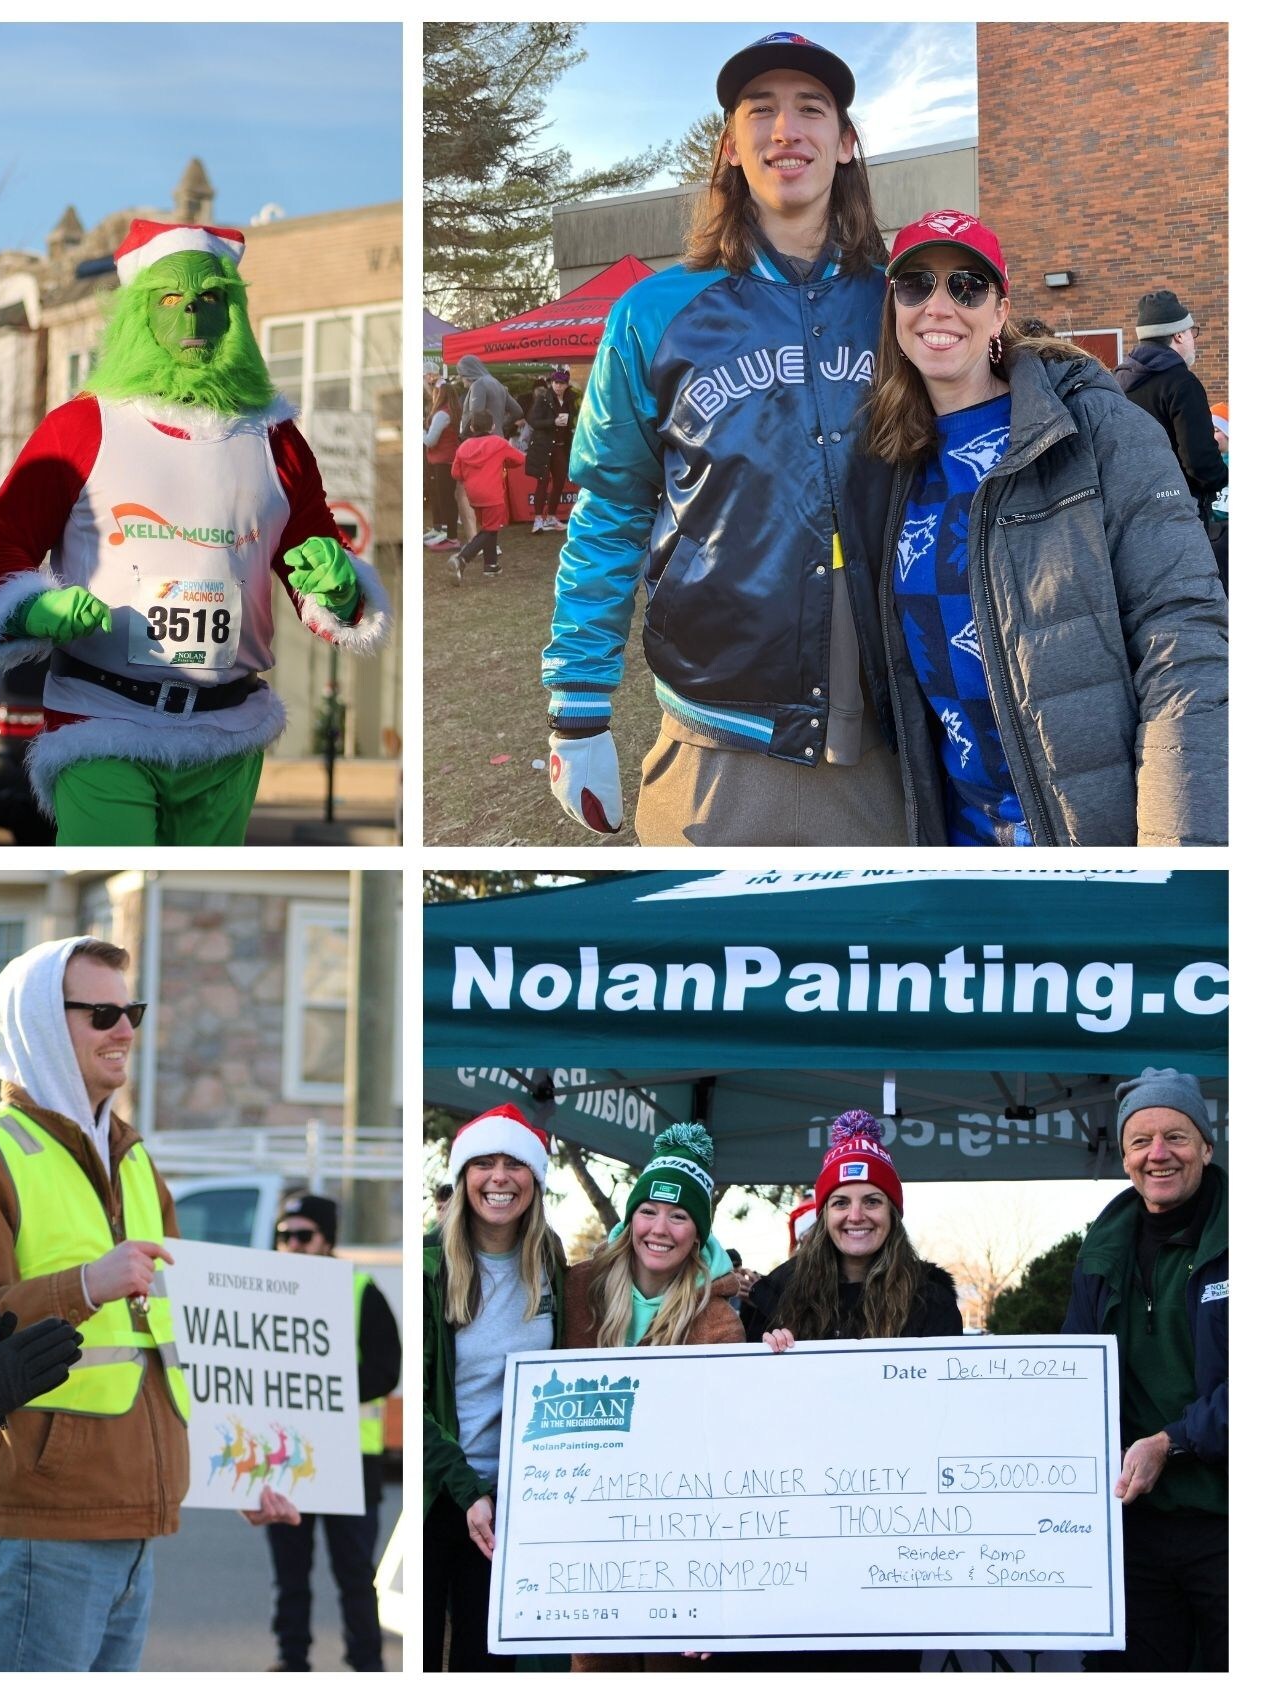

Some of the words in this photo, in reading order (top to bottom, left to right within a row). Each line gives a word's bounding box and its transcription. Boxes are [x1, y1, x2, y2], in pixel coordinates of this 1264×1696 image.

[686, 345, 805, 423] BLUE
[123, 523, 178, 541] KELLY
[182, 526, 235, 545] MUSIC
[183, 580, 204, 591] BRYN
[205, 581, 225, 592] MAWR
[183, 592, 213, 602] RACING
[214, 592, 225, 603] CO
[146, 605, 231, 644] 3518
[178, 651, 204, 660] NOLAN
[208, 1272, 264, 1293] REINDEER
[266, 1278, 300, 1296] ROMP
[183, 1305, 330, 1357] WALKERS
[882, 1364, 927, 1380] Date
[947, 1357, 984, 1380] Dec.
[989, 1358, 1012, 1380] 14,
[1018, 1359, 1076, 1377] 2024
[264, 1369, 344, 1413] HERE
[542, 1398, 628, 1419] NOLAN
[541, 1419, 549, 1429] IN
[550, 1419, 565, 1428] THE
[565, 1417, 625, 1428] NEIGHBORHOOD
[532, 1440, 624, 1452] NolanPainting.com
[523, 1465, 550, 1480] Pay
[556, 1467, 568, 1479] to
[571, 1463, 592, 1478] the
[588, 1471, 713, 1500] AMERICAN
[724, 1468, 807, 1496] CANCER
[824, 1467, 911, 1495] SOCIETY
[522, 1487, 559, 1502] Order
[561, 1488, 577, 1504] of
[829, 1505, 973, 1536] THOUSAND
[1037, 1518, 1094, 1535] Dollars
[897, 1545, 966, 1562] Reindeer
[980, 1544, 1026, 1565] Romp
[549, 1560, 675, 1593] REINDEER
[688, 1559, 755, 1589] ROMP
[758, 1560, 808, 1587] 2024
[868, 1564, 953, 1588] Participants
[985, 1563, 1066, 1588] Sponsors
[516, 1578, 540, 1595] For
